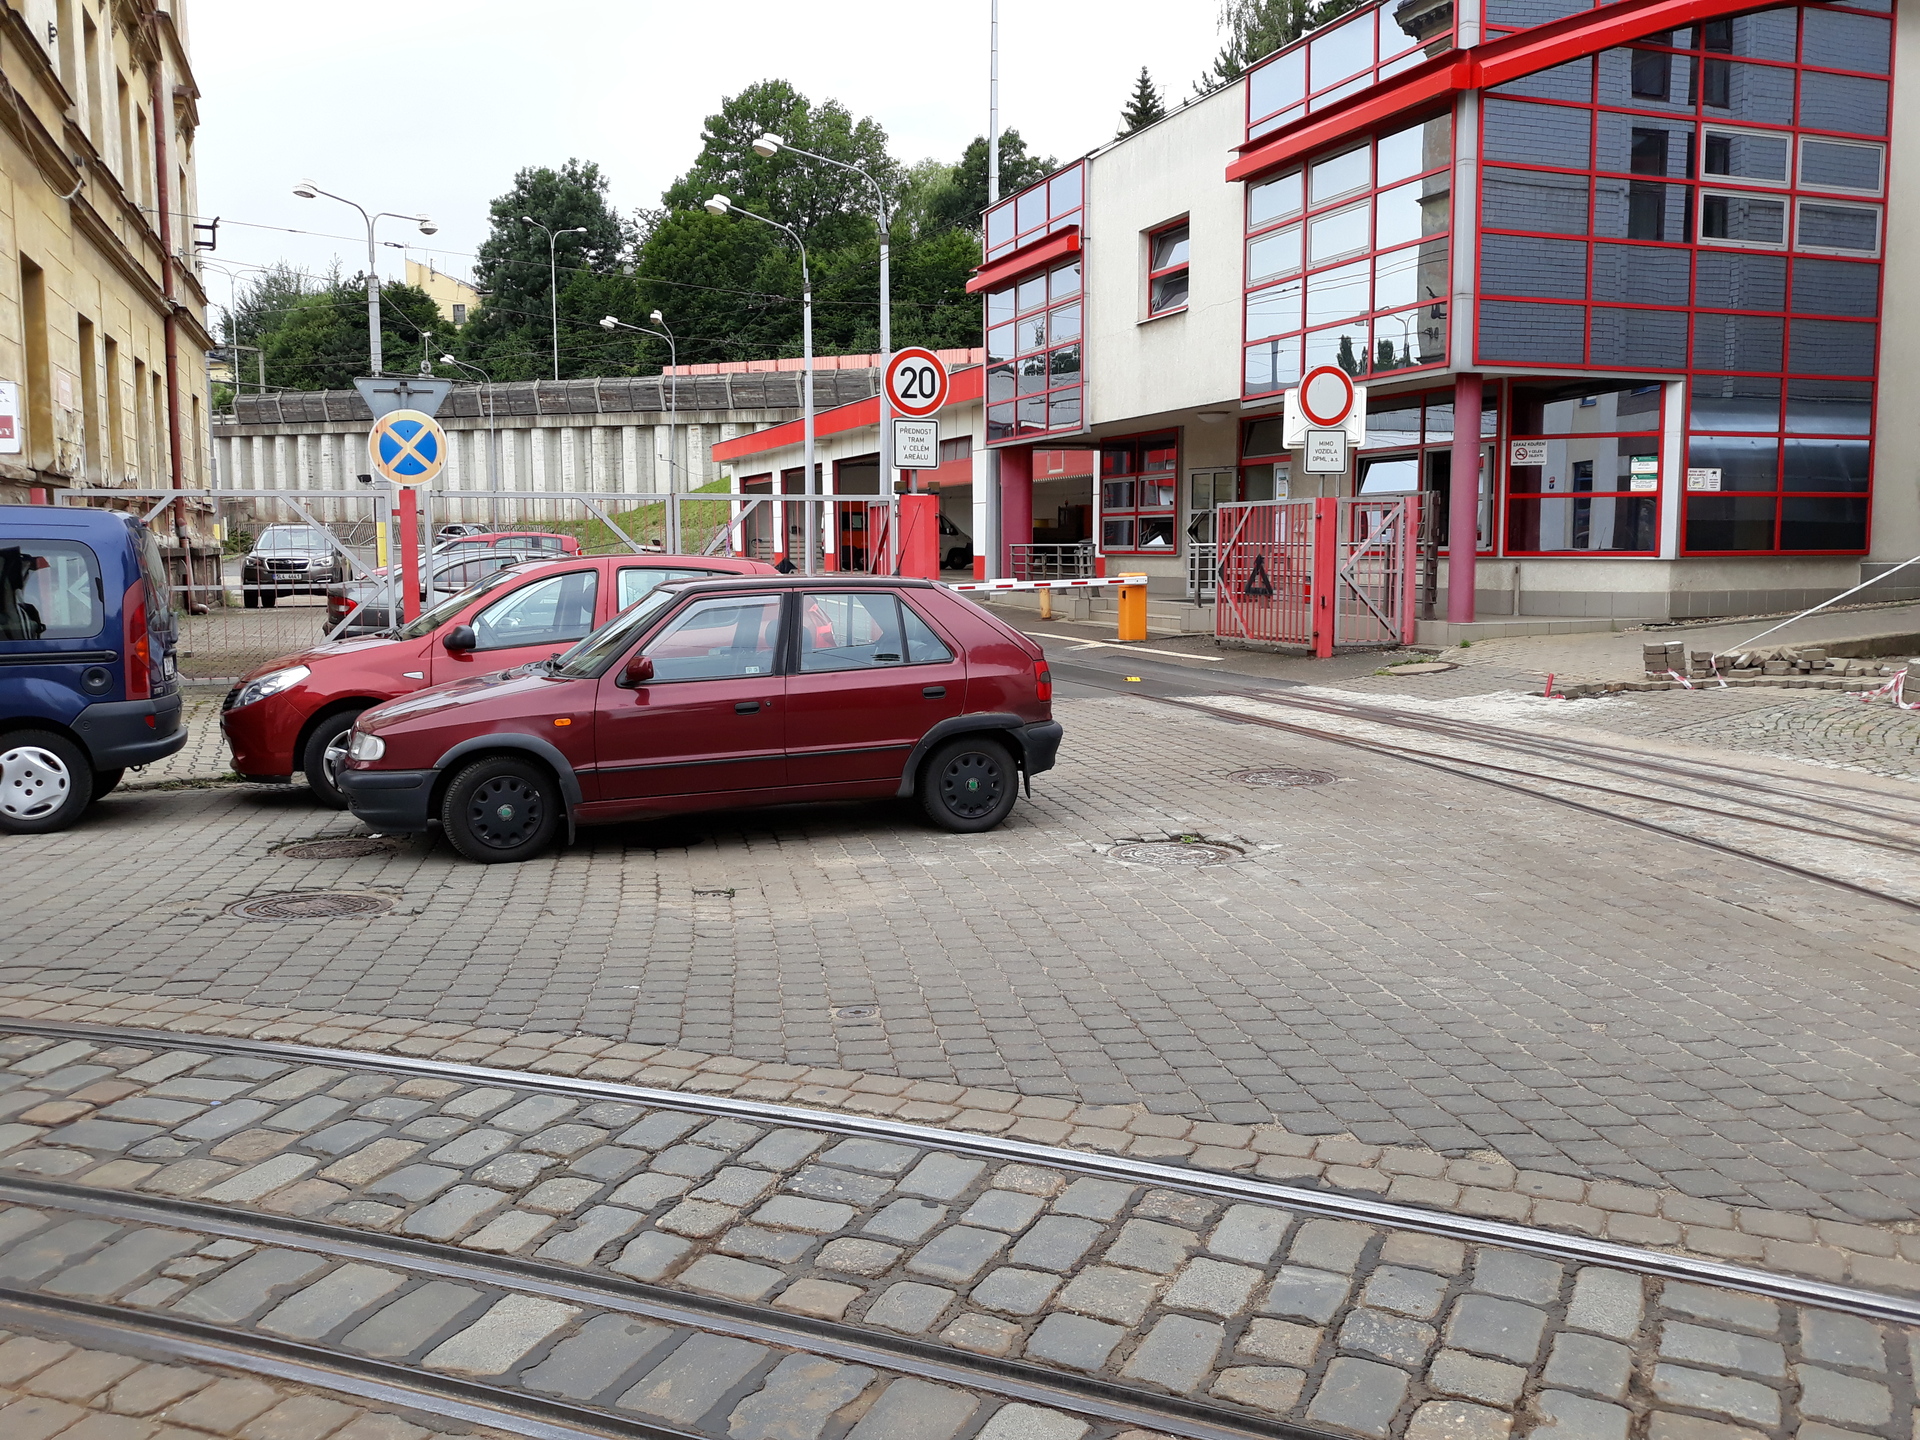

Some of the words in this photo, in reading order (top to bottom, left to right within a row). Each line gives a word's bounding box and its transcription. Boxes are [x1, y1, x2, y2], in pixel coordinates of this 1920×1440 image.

[900, 366, 935, 398] 20
[900, 426, 932, 435] PŘEDNOST
[909, 444, 929, 452] CELÉM
[904, 452, 928, 460] AREÁLU
